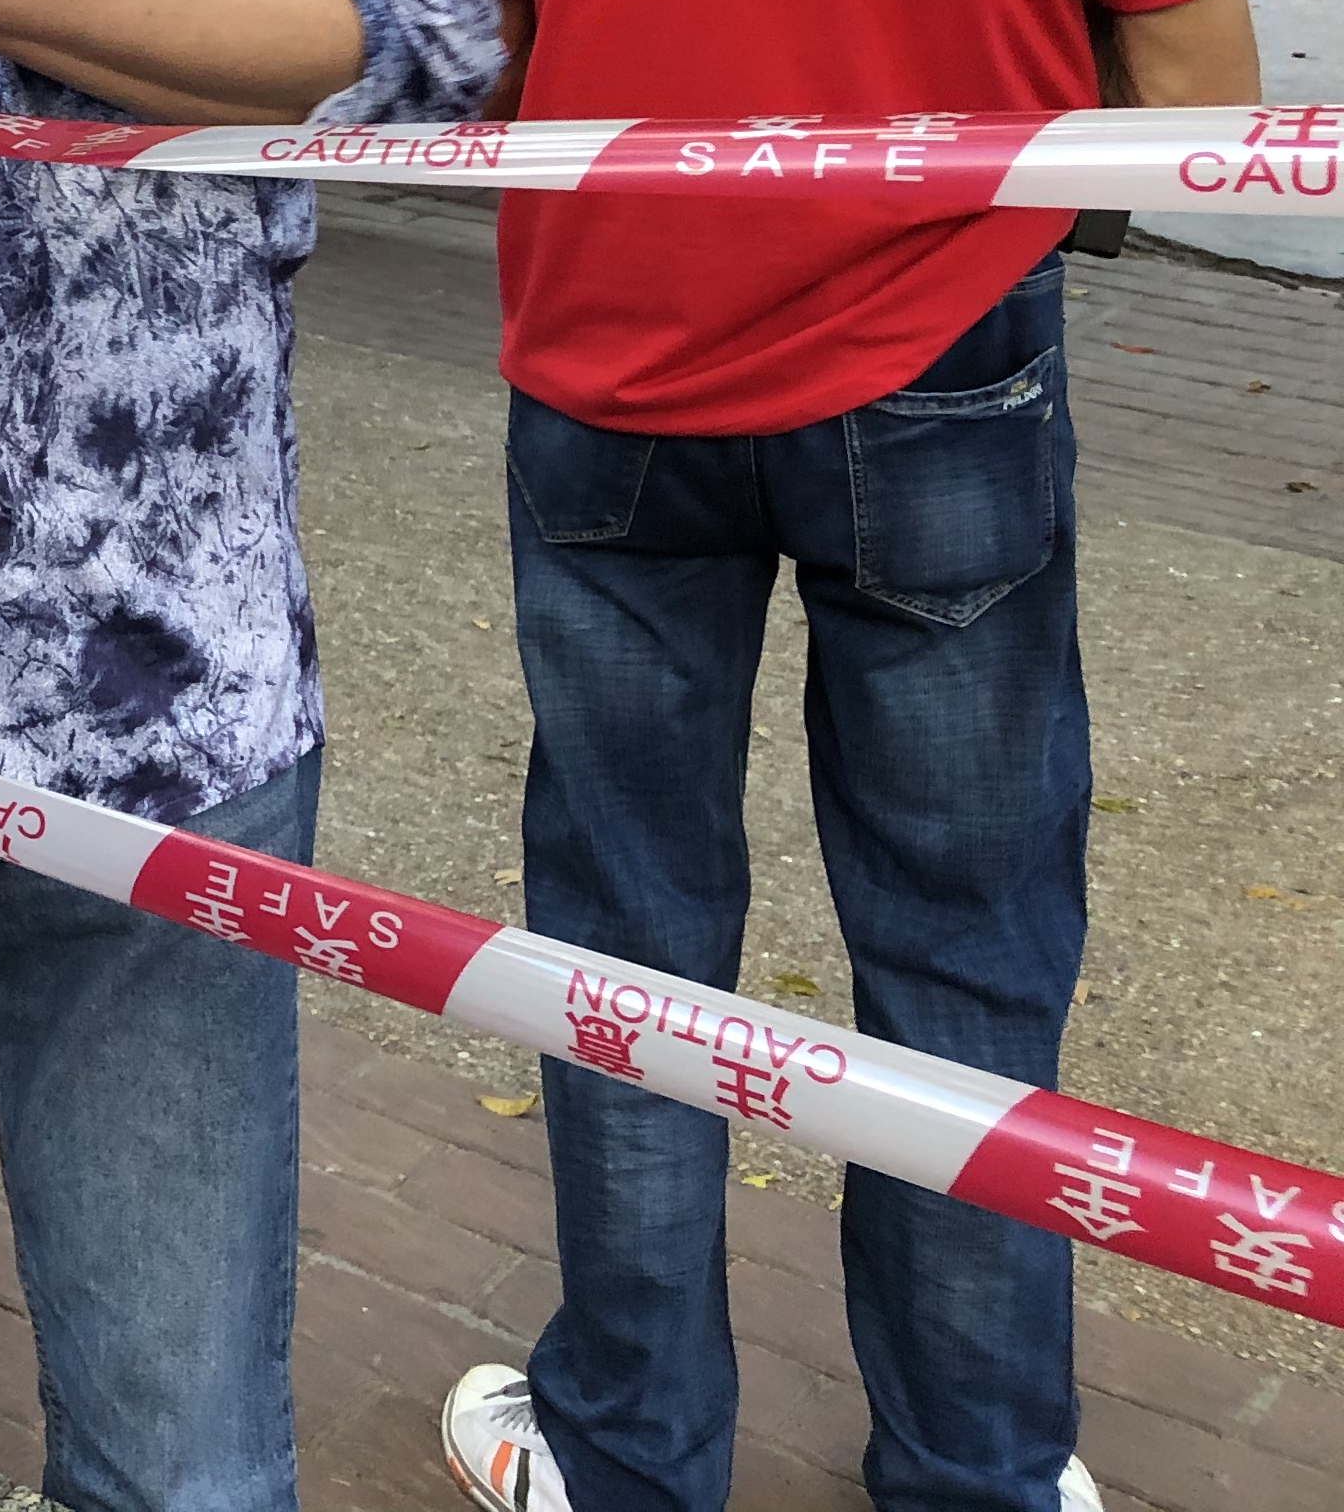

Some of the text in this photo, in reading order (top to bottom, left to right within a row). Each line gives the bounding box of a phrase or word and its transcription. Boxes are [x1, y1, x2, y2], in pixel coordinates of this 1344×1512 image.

[259, 137, 506, 170] CAUTION
[674, 141, 927, 183] SAFE
[1178, 150, 1339, 197] CAU
[184, 890, 368, 988] 安全
[206, 859, 406, 952] SAFE
[564, 967, 850, 1087] CAUTION
[564, 1009, 796, 1132] 注意
[1044, 1161, 1315, 1298] 安全
